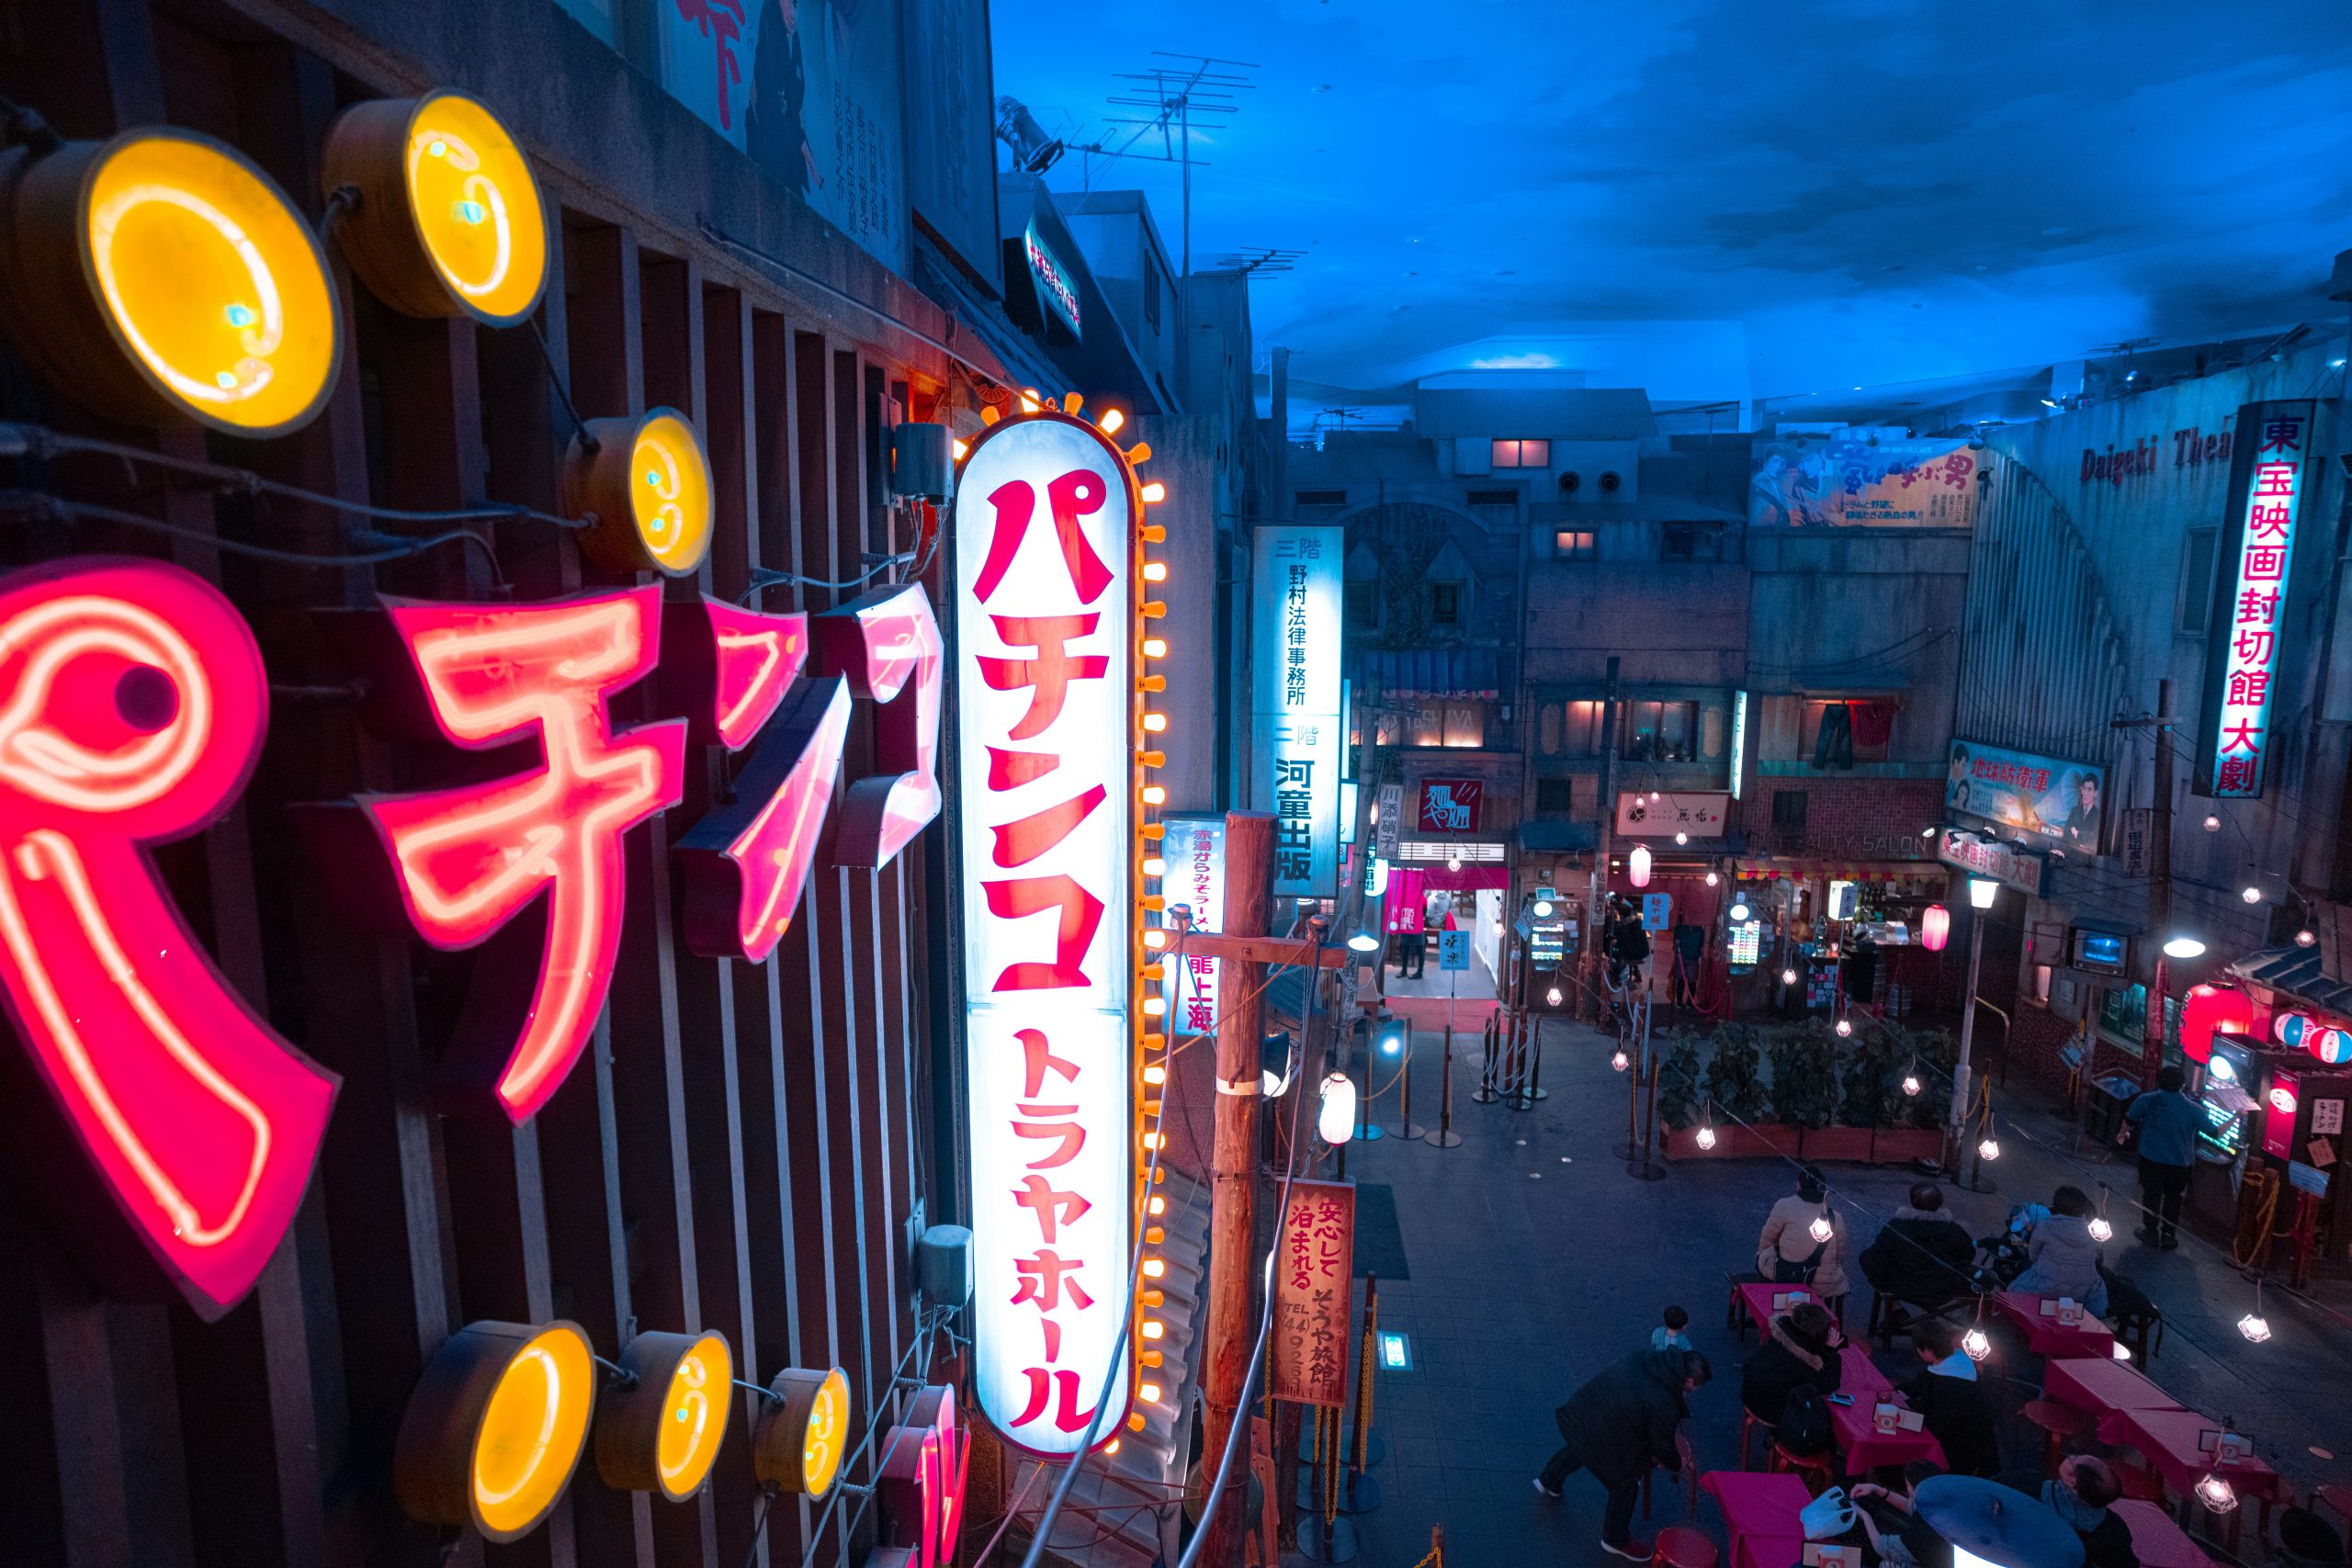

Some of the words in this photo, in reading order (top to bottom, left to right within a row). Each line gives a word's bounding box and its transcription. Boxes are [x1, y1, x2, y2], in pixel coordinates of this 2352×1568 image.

[2080, 434, 2158, 486] Daigeki
[1274, 537, 1322, 560] 三階
[2226, 416, 2306, 707] 東宝映画封切館
[1286, 564, 1307, 706] 野村法律事務所
[972, 468, 1115, 994] パチンコ
[1273, 725, 1318, 747] 二階
[2216, 717, 2265, 794] 大劇
[1970, 757, 2051, 793] 地球防衛軍
[1274, 759, 1315, 882] 河童出版
[1380, 788, 1398, 848] 川添硝子
[1862, 835, 1928, 853] SALON
[1193, 829, 1213, 932] 赤湯からみそラーメ
[1008, 1027, 1097, 1435] トラヤホール
[1288, 1205, 1315, 1291] 泊まれる
[1314, 1198, 1346, 1278] 安心して
[1281, 1317, 1311, 1336] (44)
[1285, 1303, 1309, 1316] TEL
[1884, 1418, 1890, 1427] 8
